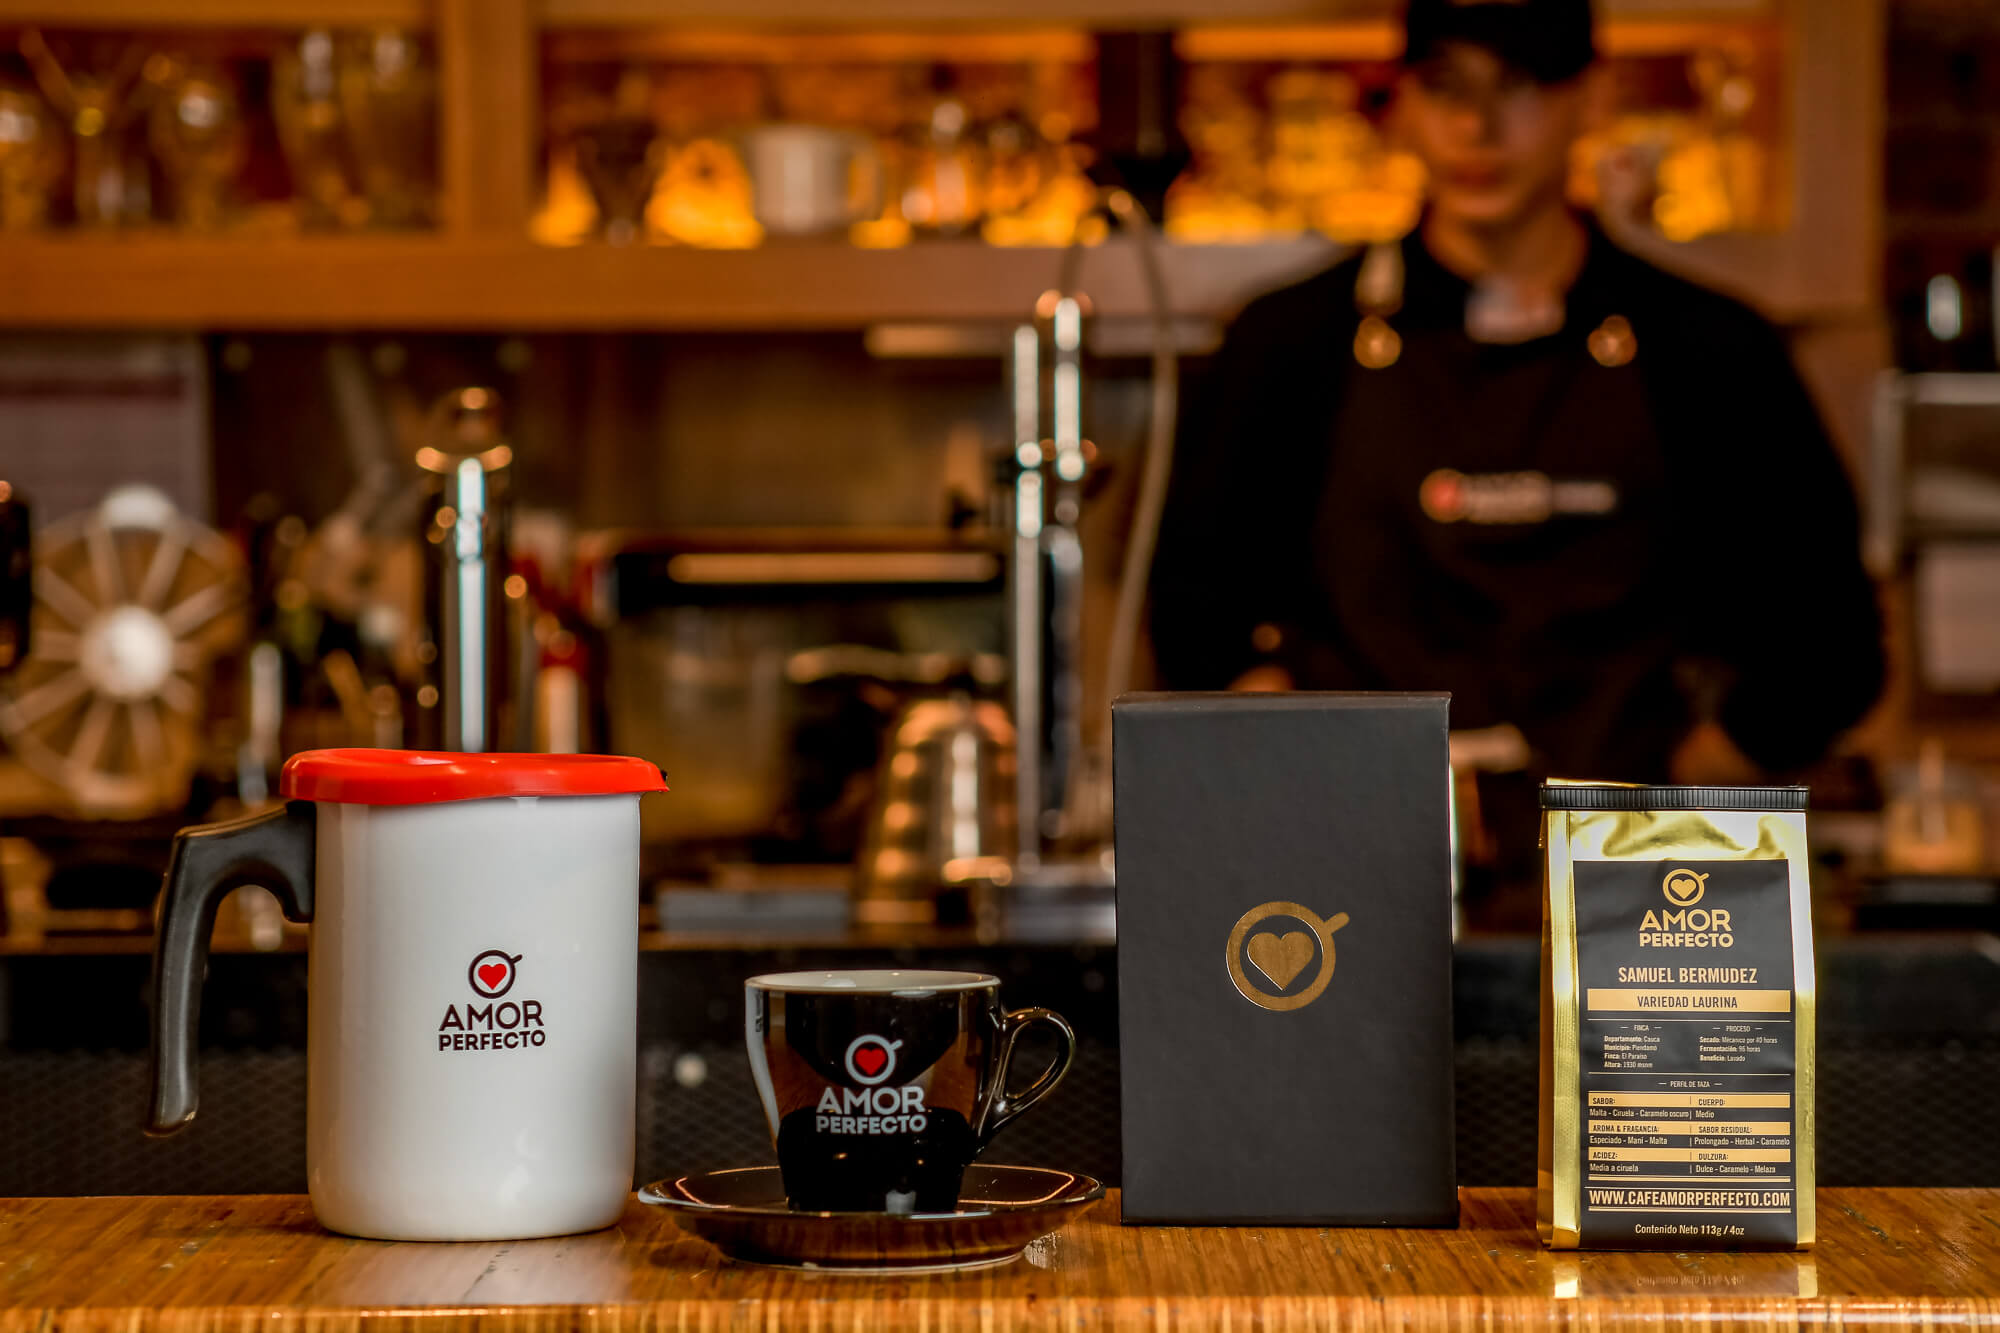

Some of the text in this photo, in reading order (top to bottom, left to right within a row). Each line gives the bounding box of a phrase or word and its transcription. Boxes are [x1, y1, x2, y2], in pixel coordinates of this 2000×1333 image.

[1639, 909, 1732, 931] AMOR
[1639, 933, 1734, 948] PERFECTO
[1618, 967, 1758, 983] SAMUEL BERMUDEZ
[1638, 996, 1738, 1008] VARIEDAD LAURINA
[439, 1000, 544, 1031] AMOR
[439, 1030, 545, 1051] PERFECTO
[816, 1086, 925, 1115] AMOR
[816, 1115, 927, 1134] PERFECTO
[1590, 1136, 1621, 1144] Especiado
[1694, 1138, 1729, 1146] Prolongado
[1589, 1190, 1790, 1206] WWW.CAFEAMORPERFECTO.COM
[1635, 1224, 1678, 1234] Contenido
[1679, 1225, 1698, 1234] Neto
[1701, 1225, 1722, 1236] 113g
[1730, 1226, 1744, 1235] 4oz
